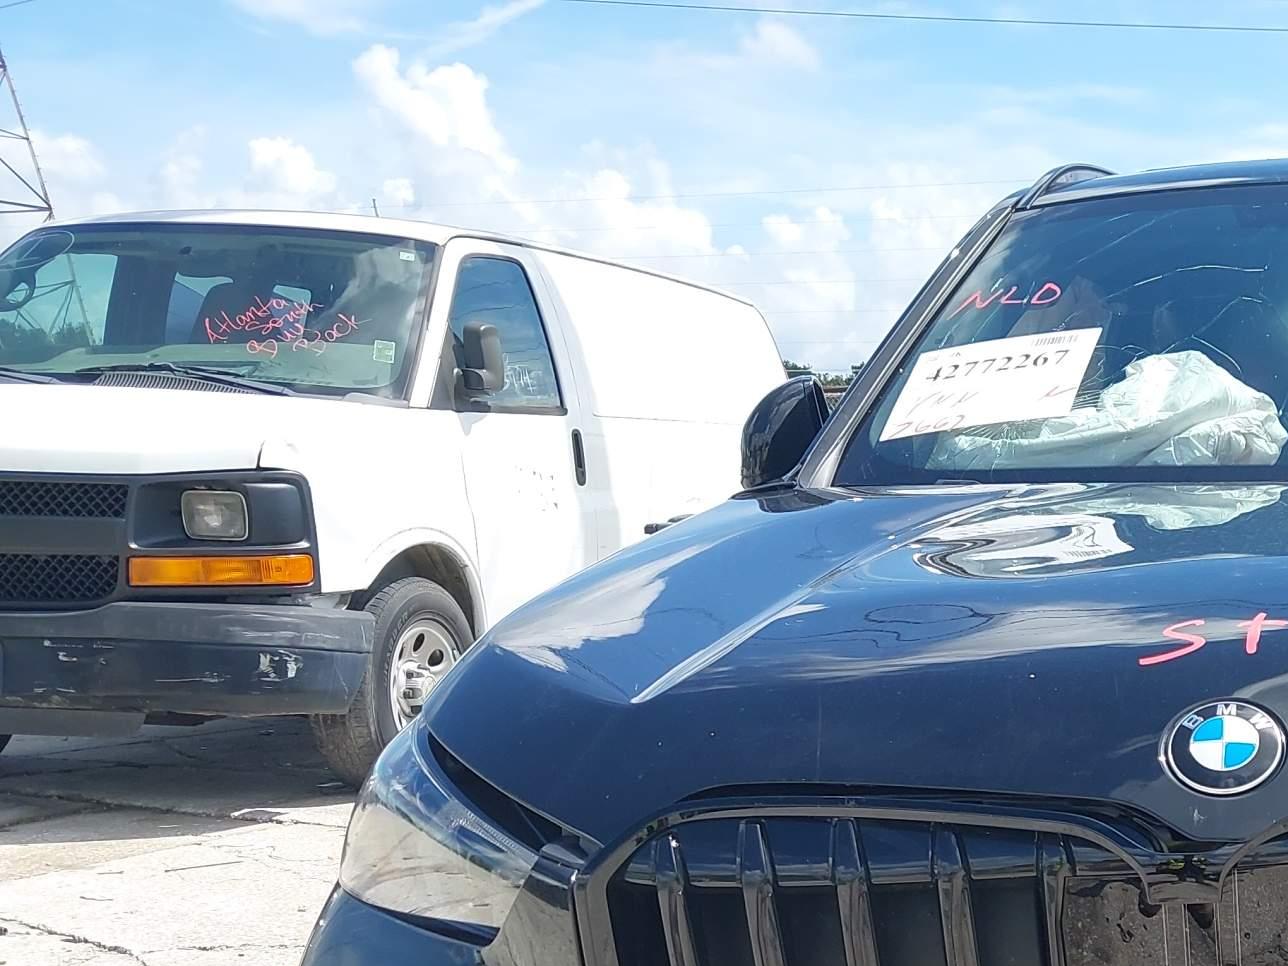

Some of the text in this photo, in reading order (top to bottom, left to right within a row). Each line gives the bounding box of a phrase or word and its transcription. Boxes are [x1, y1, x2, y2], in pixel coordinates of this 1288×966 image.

[204, 295, 290, 344] Atlanta
[246, 299, 324, 335] South
[925, 349, 1070, 382] 42772267
[1182, 703, 1274, 731] BMW
